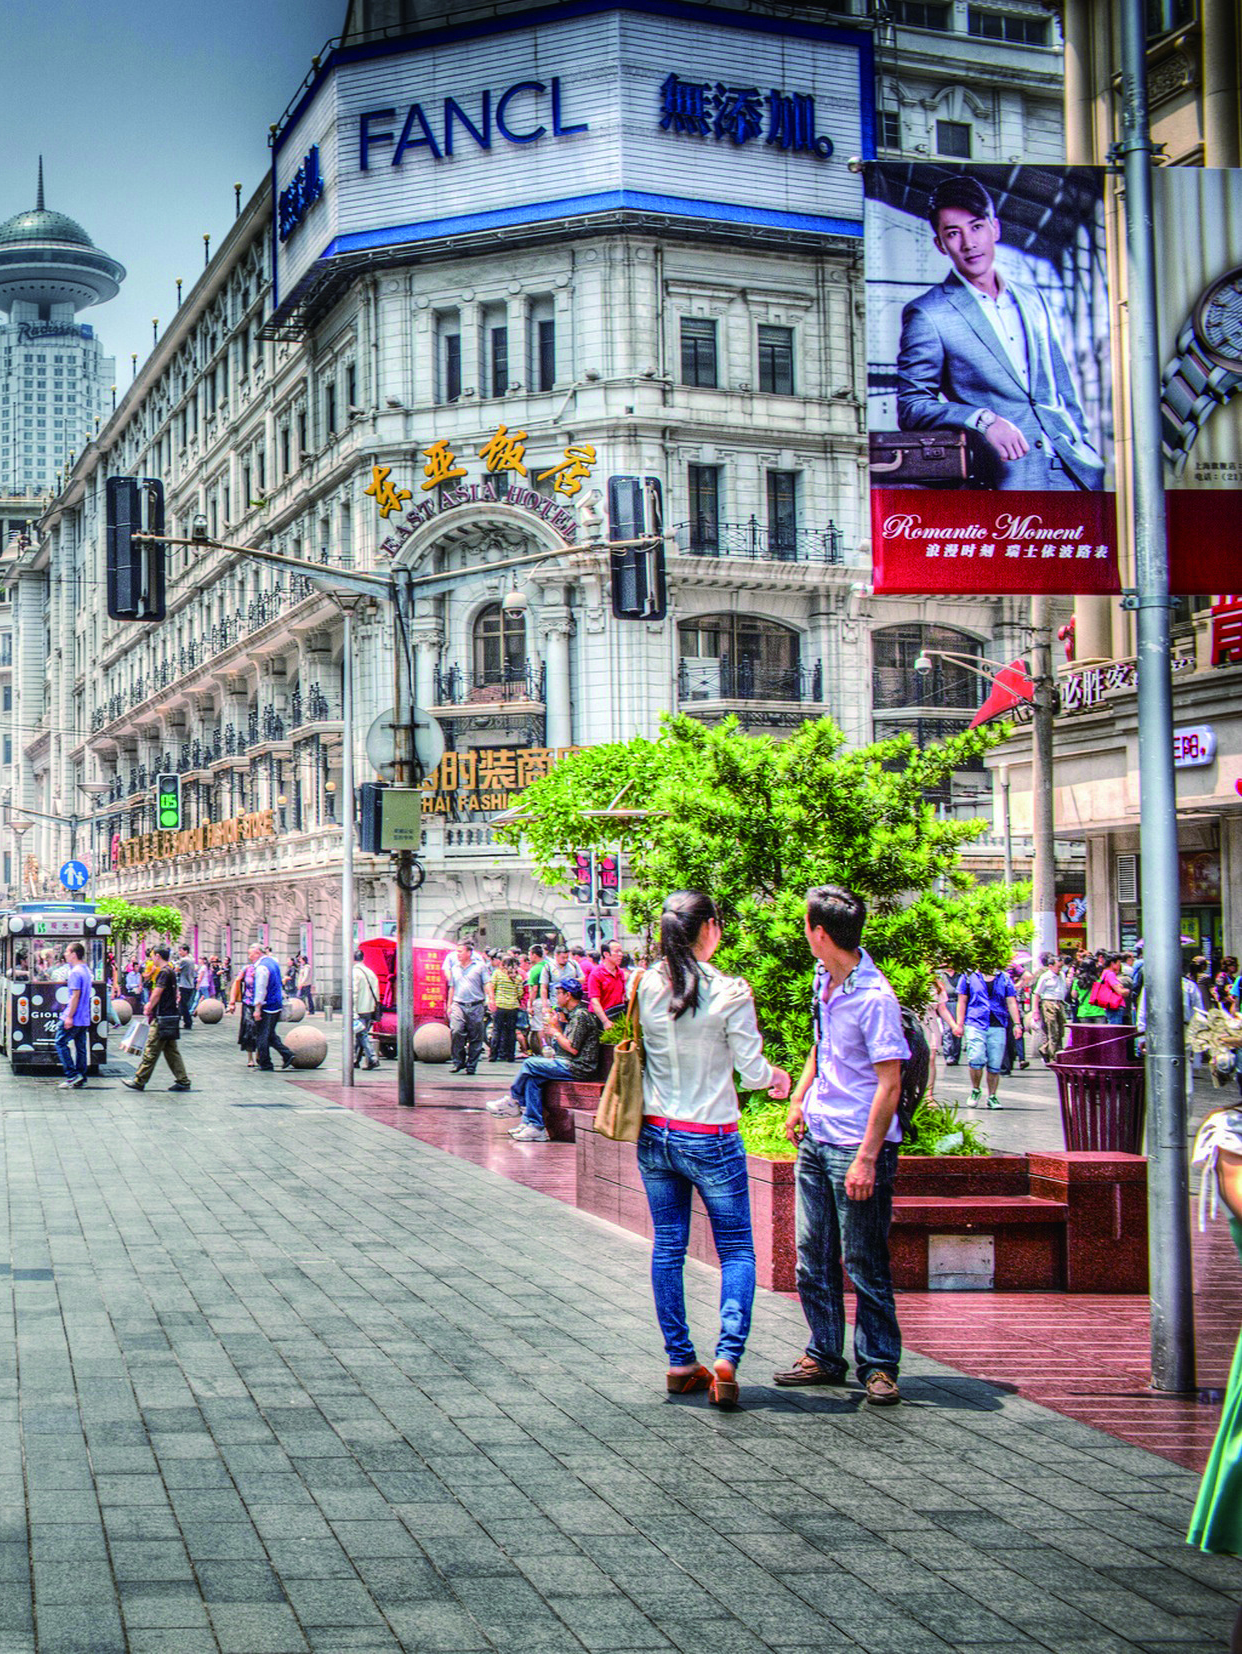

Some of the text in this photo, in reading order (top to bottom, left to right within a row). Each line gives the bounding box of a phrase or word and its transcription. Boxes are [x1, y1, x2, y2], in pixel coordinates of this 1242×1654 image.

[359, 76, 588, 171] FANCL
[379, 481, 581, 557] EAST ASIA HOTEL
[882, 512, 1084, 541] Romantic Moment
[925, 543, 996, 559] 浪漫时刻
[160, 794, 177, 809] 05
[457, 793, 511, 811] FASHI
